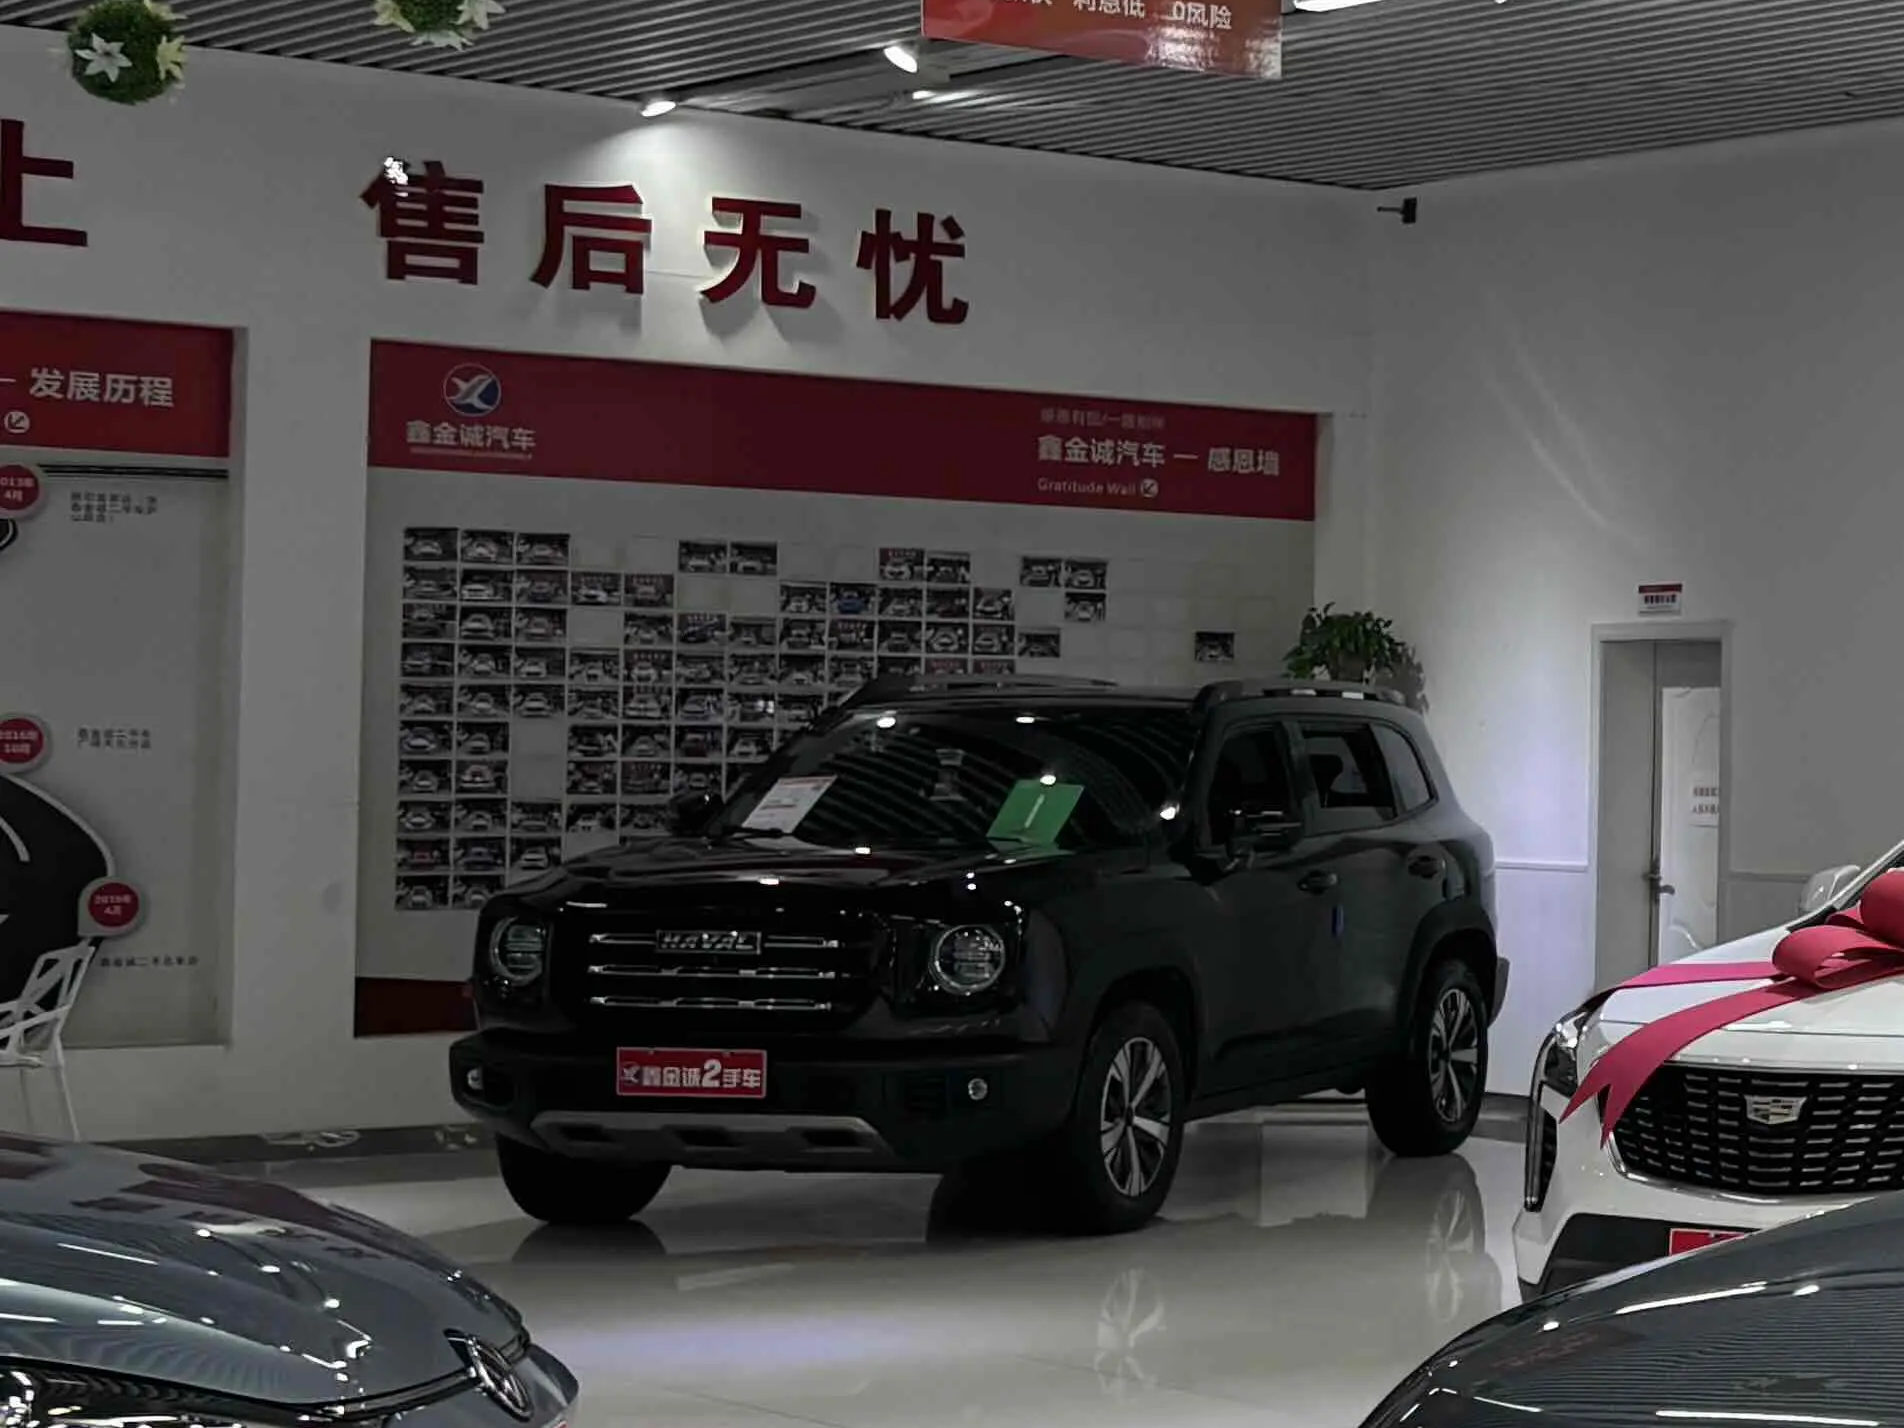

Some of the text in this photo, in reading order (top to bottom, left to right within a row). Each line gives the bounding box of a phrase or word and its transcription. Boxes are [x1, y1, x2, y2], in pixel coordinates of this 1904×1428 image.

[360, 160, 969, 325] 售后无忧
[29, 366, 175, 408] 发展历程
[406, 419, 536, 450] 鑫金诚汽车
[1038, 434, 1166, 468] 鑫金诚汽车
[1207, 447, 1281, 476] 感恩墙
[1038, 477, 1137, 498] Gratitude Wall
[660, 933, 754, 951] HAVAL
[642, 1058, 762, 1088] 鑫金诚2手车
